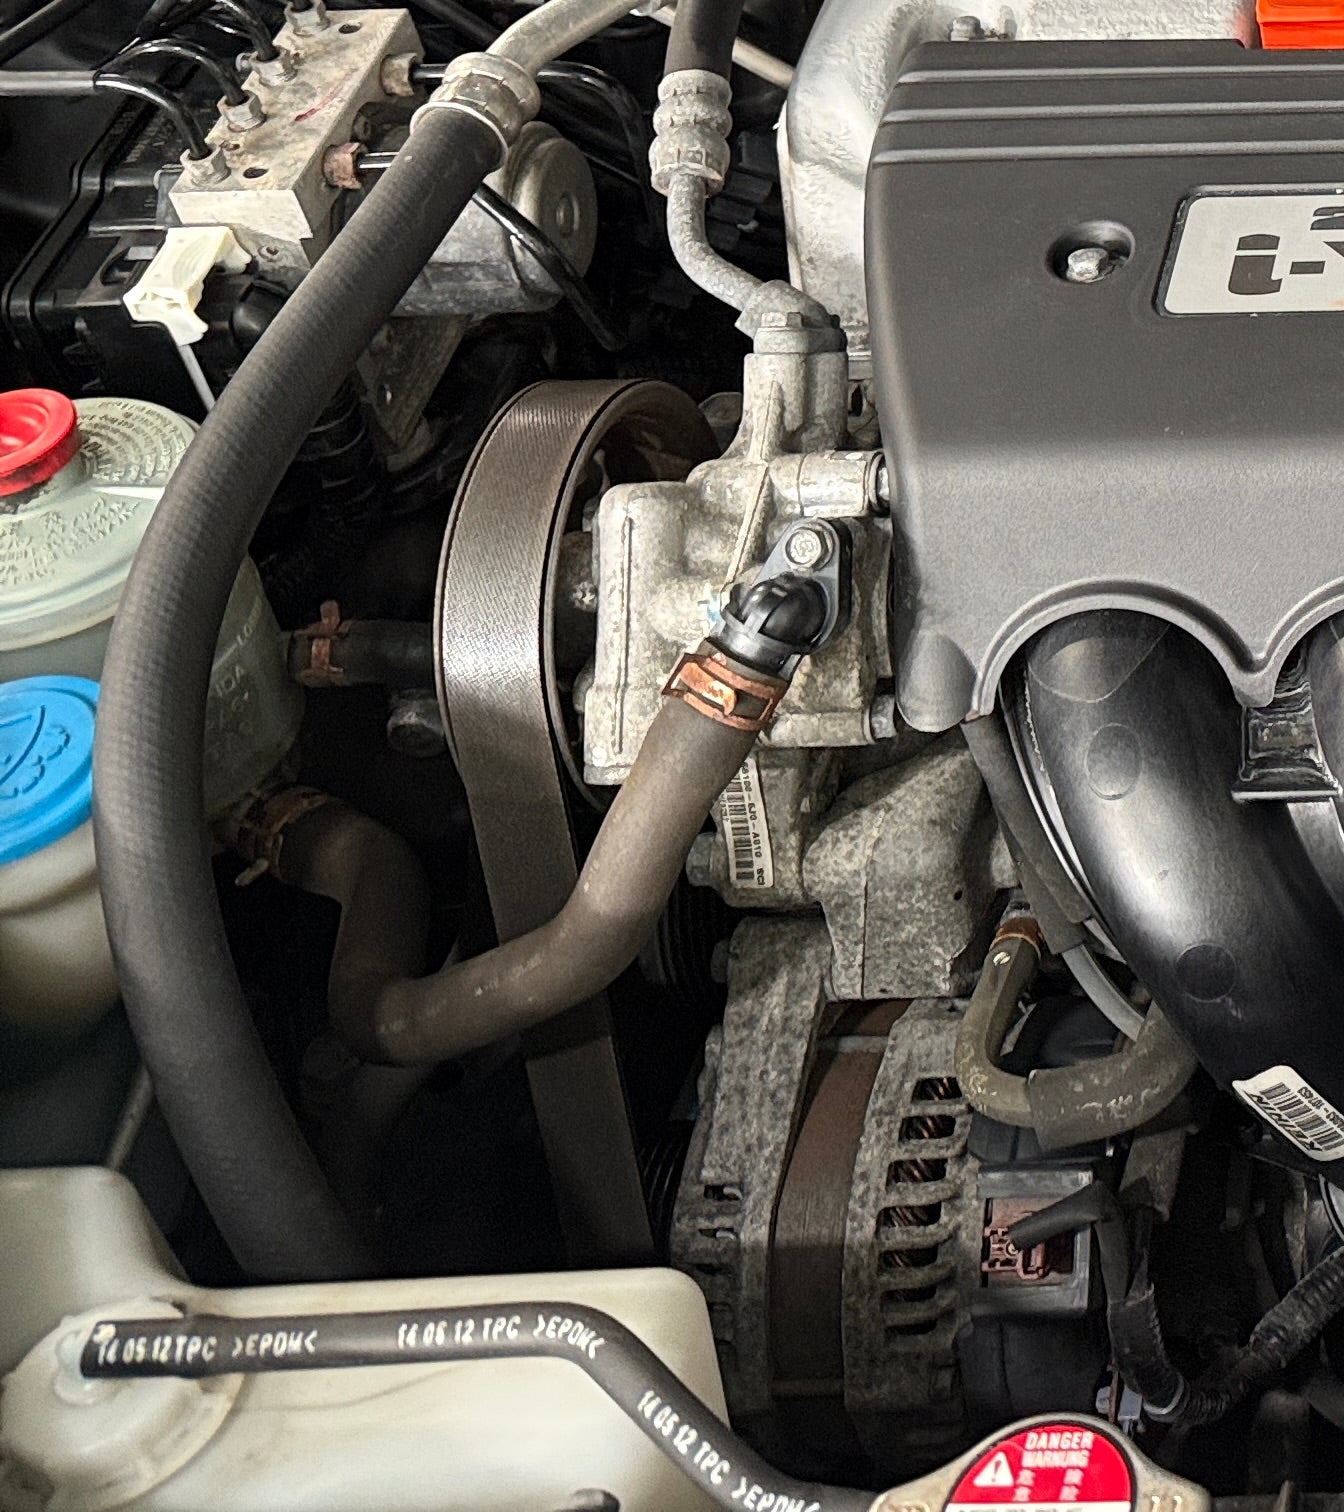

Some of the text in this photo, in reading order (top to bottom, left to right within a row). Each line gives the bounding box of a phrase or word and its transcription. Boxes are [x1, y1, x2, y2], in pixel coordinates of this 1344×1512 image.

[454, 1320, 474, 1345] 12
[482, 1315, 519, 1341] TPC
[174, 1335, 215, 1362] TPC
[653, 1405, 680, 1437] 05
[673, 1424, 698, 1456] 12
[693, 1441, 731, 1485] TPC
[1024, 1431, 1093, 1450] DANGER
